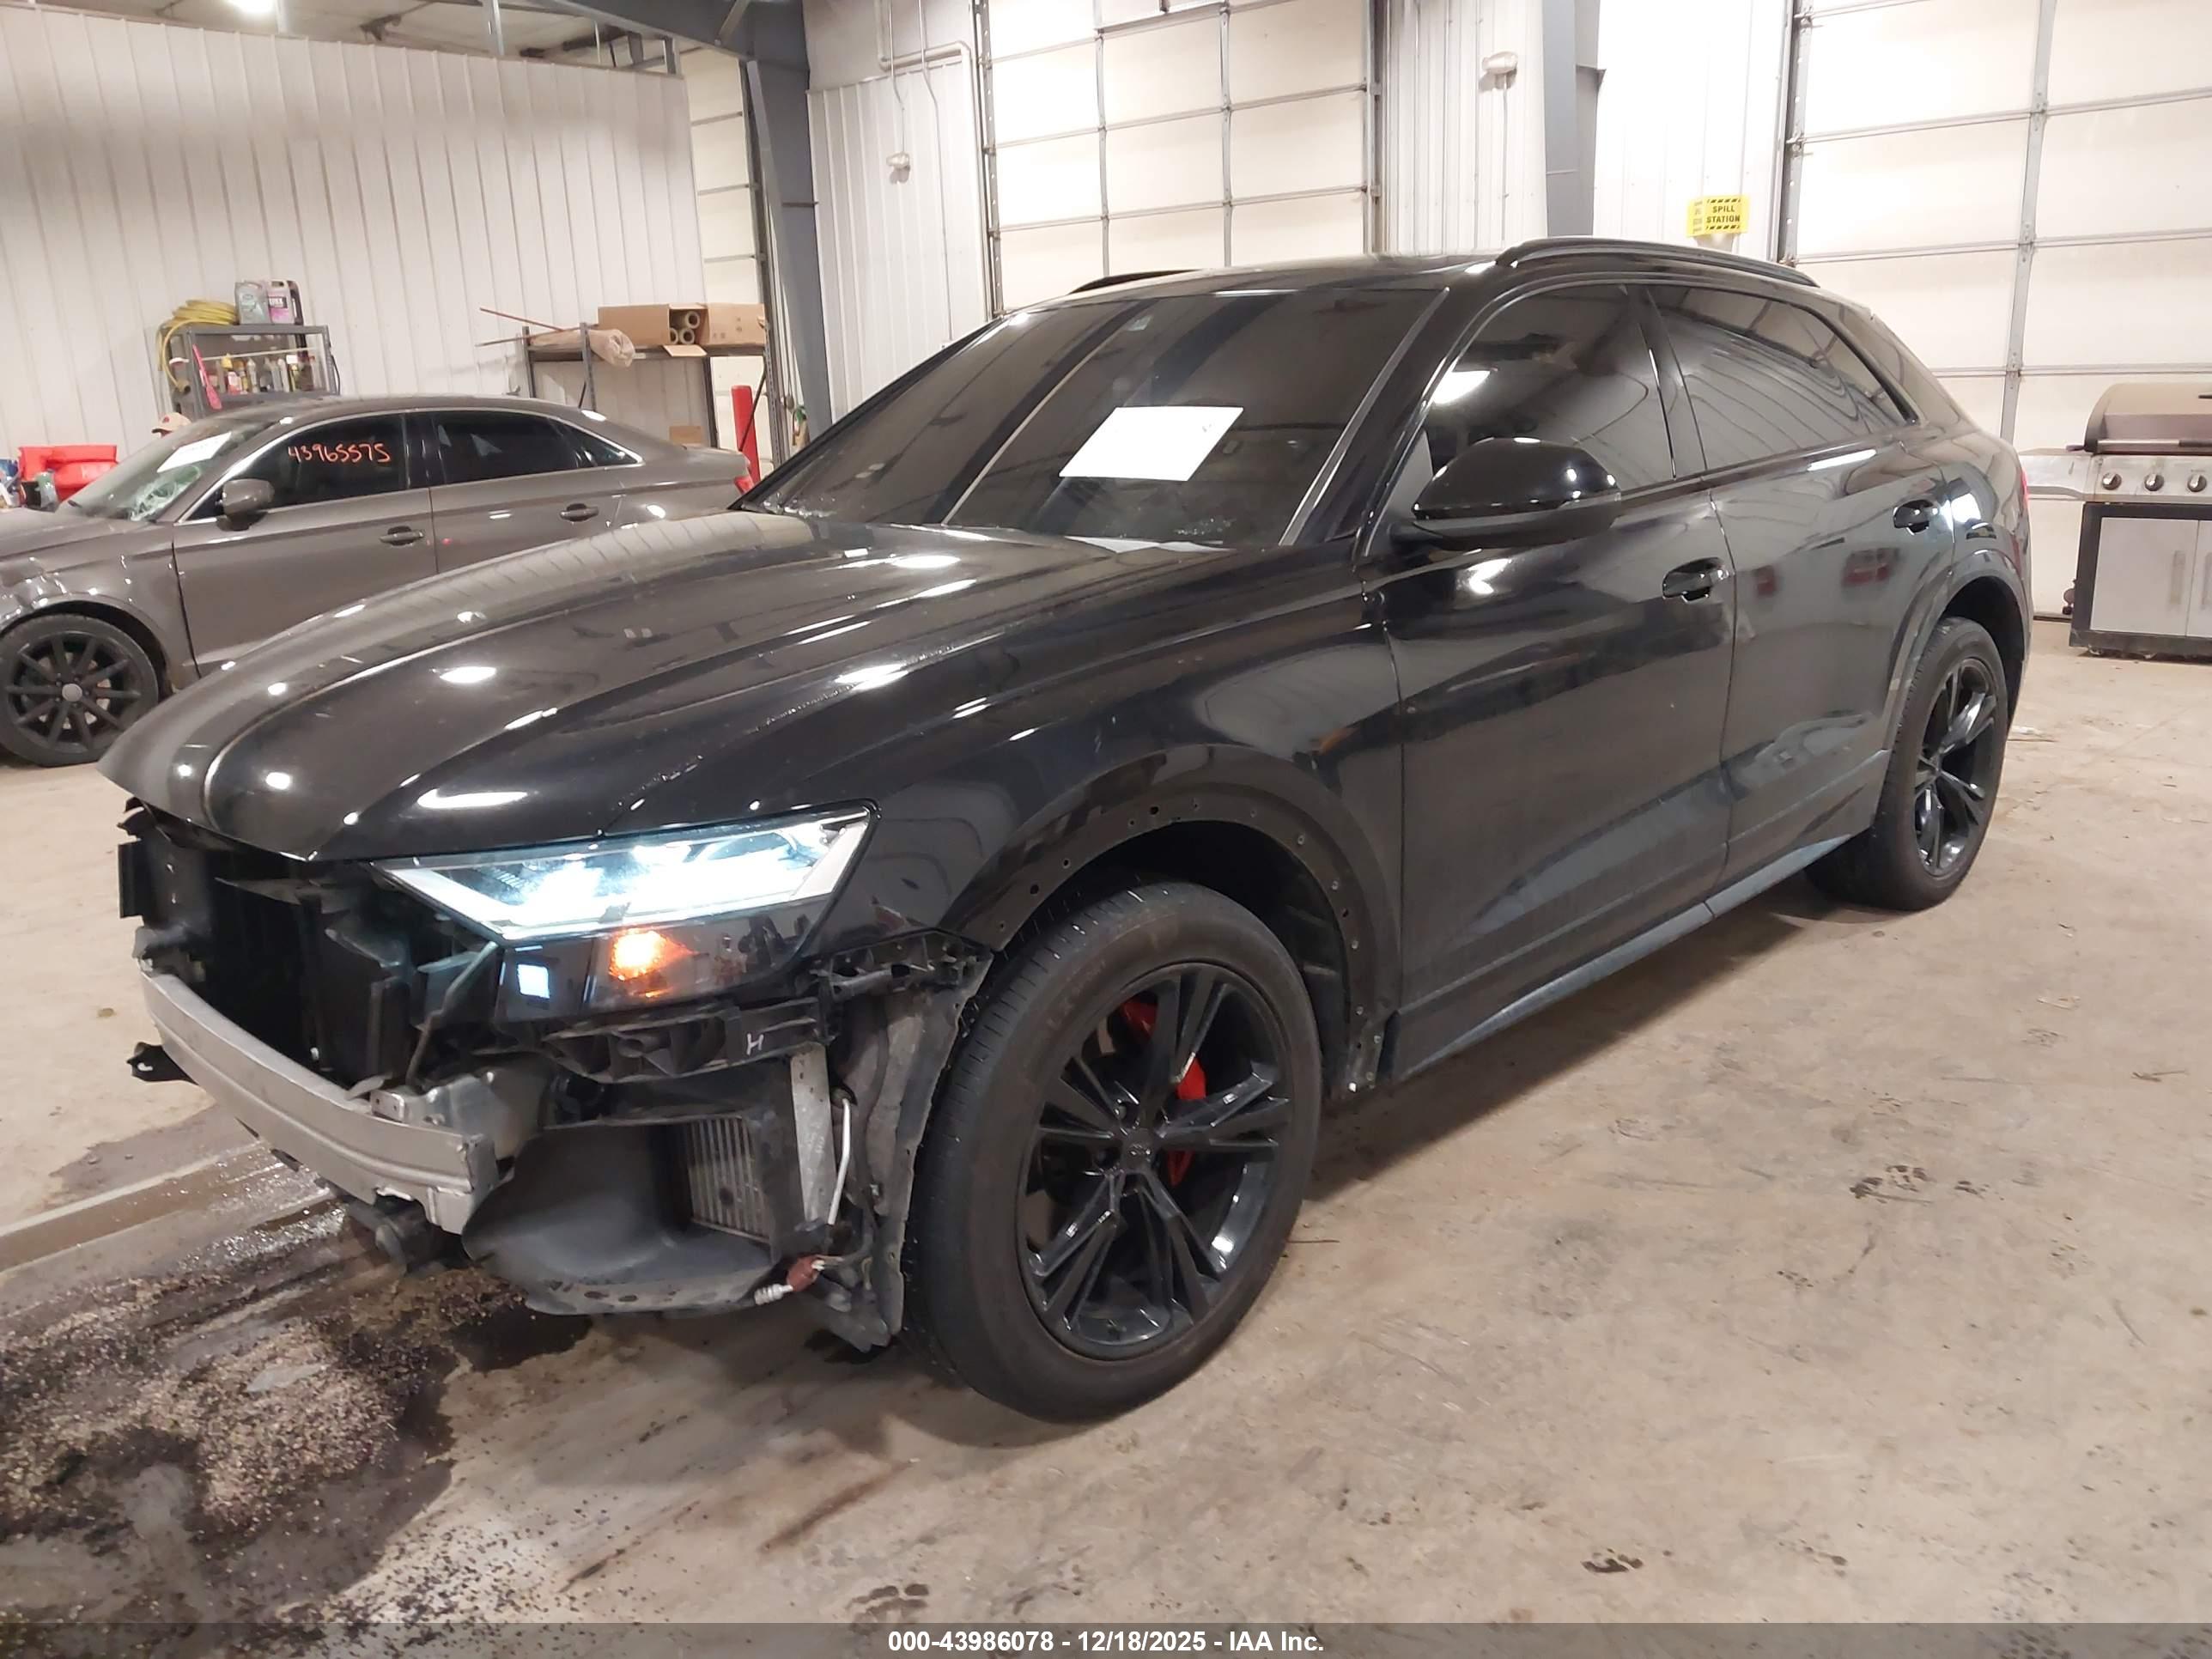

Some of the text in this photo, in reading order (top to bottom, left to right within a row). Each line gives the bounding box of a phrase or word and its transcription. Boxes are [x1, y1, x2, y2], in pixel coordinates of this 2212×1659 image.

[1712, 205, 1735, 214] SPILL
[1706, 215, 1741, 223] STATION
[288, 442, 392, 464] 43965575
